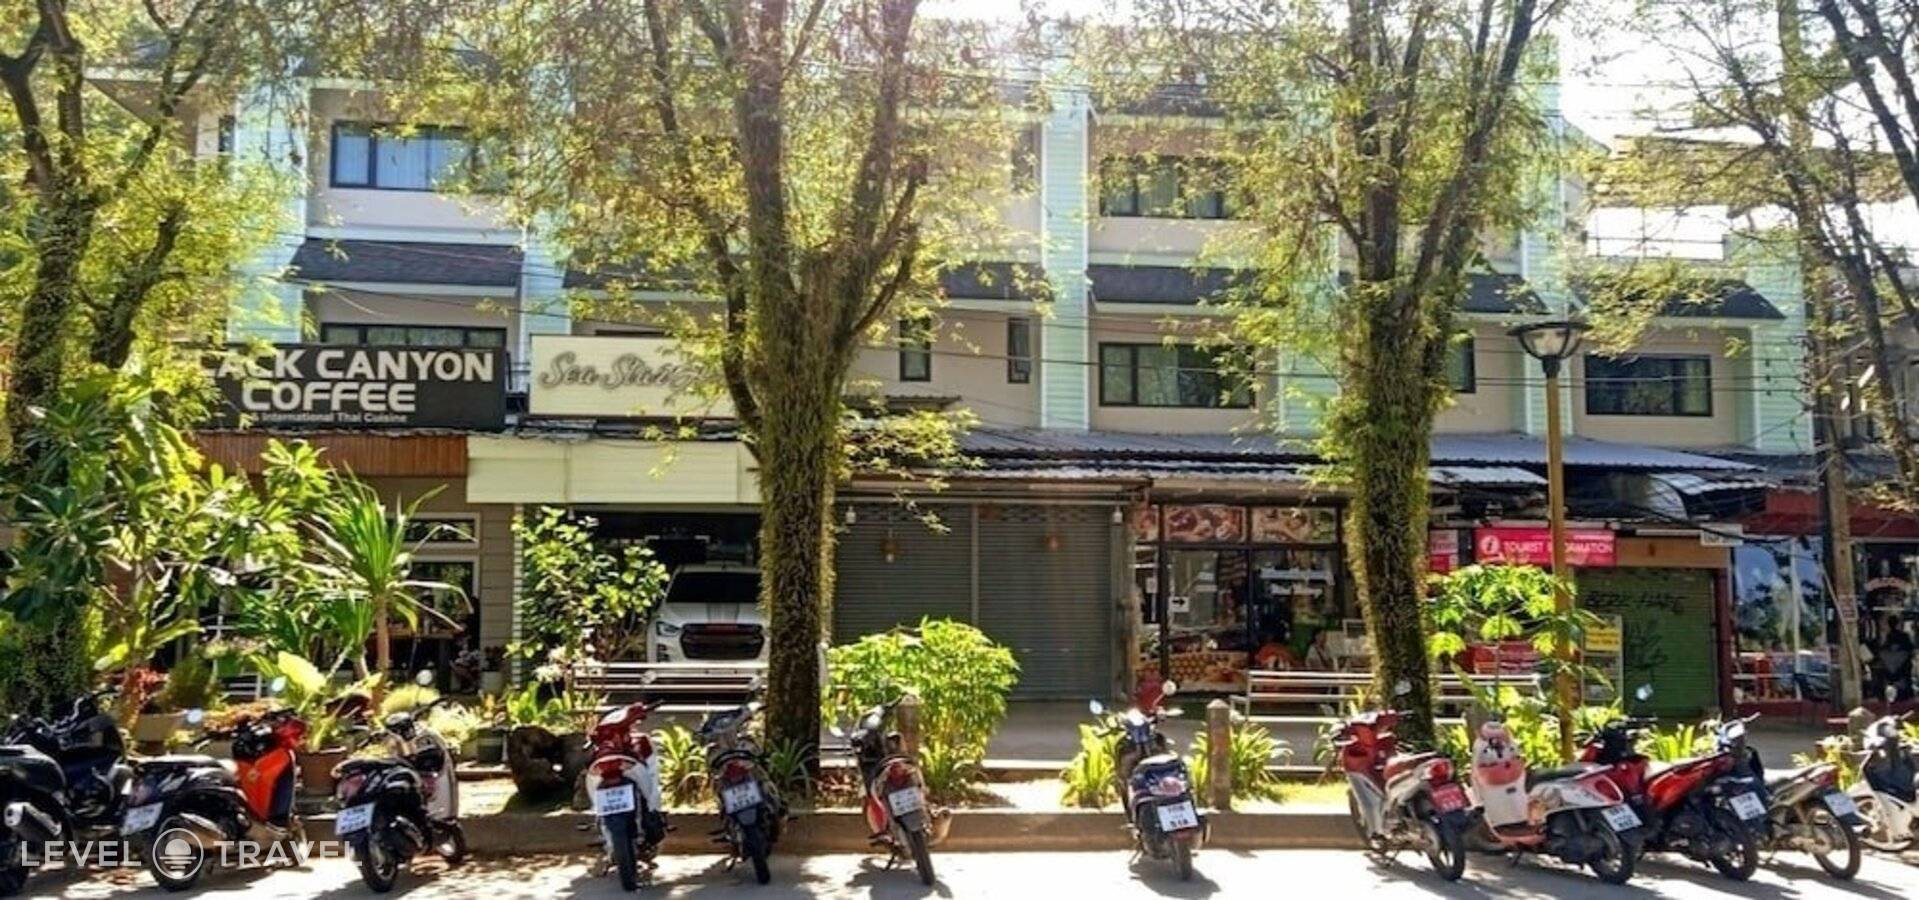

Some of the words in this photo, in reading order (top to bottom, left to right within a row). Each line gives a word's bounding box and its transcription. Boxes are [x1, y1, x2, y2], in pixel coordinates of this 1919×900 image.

[315, 350, 493, 382] CANYON
[241, 380, 416, 412] COFFEE
[261, 411, 334, 423] International
[337, 412, 361, 423] Thai
[363, 413, 407, 424] Cuisine
[1504, 541, 1545, 553] TOURIST
